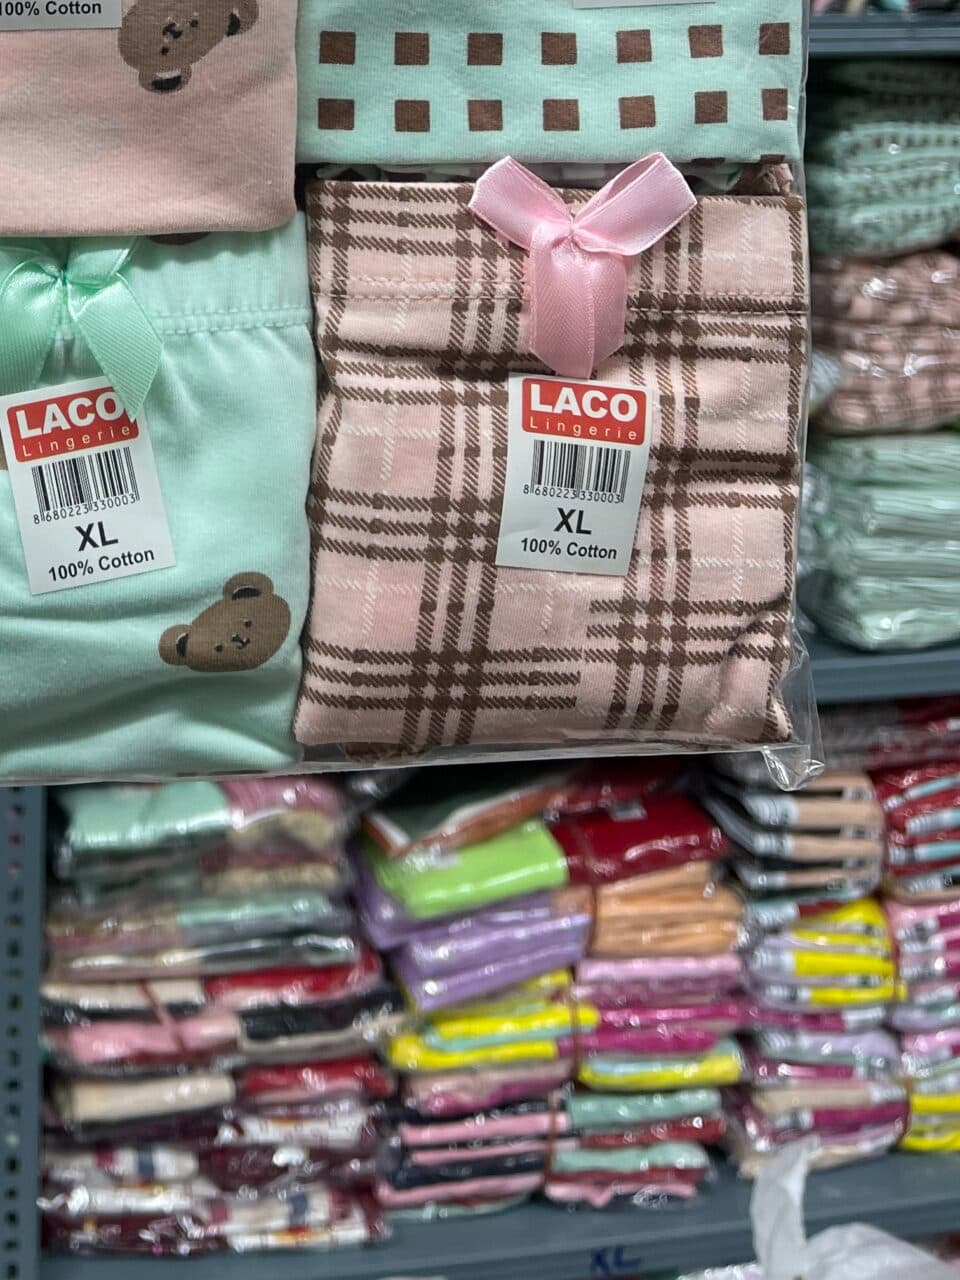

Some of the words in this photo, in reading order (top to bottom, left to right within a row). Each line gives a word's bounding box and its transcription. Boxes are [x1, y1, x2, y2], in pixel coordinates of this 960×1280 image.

[45, 0, 102, 15] Cotton
[15, 391, 126, 439] LACO
[530, 384, 638, 422] LACO
[22, 426, 130, 457] Lingerie
[530, 417, 636, 440] Lingerie
[75, 521, 119, 551] XL
[553, 507, 592, 535] XL
[521, 538, 561, 555] 100%
[567, 542, 617, 559] Cotton
[48, 559, 94, 581] 100%
[98, 549, 155, 571] Cotton
[589, 1246, 641, 1276] XL
